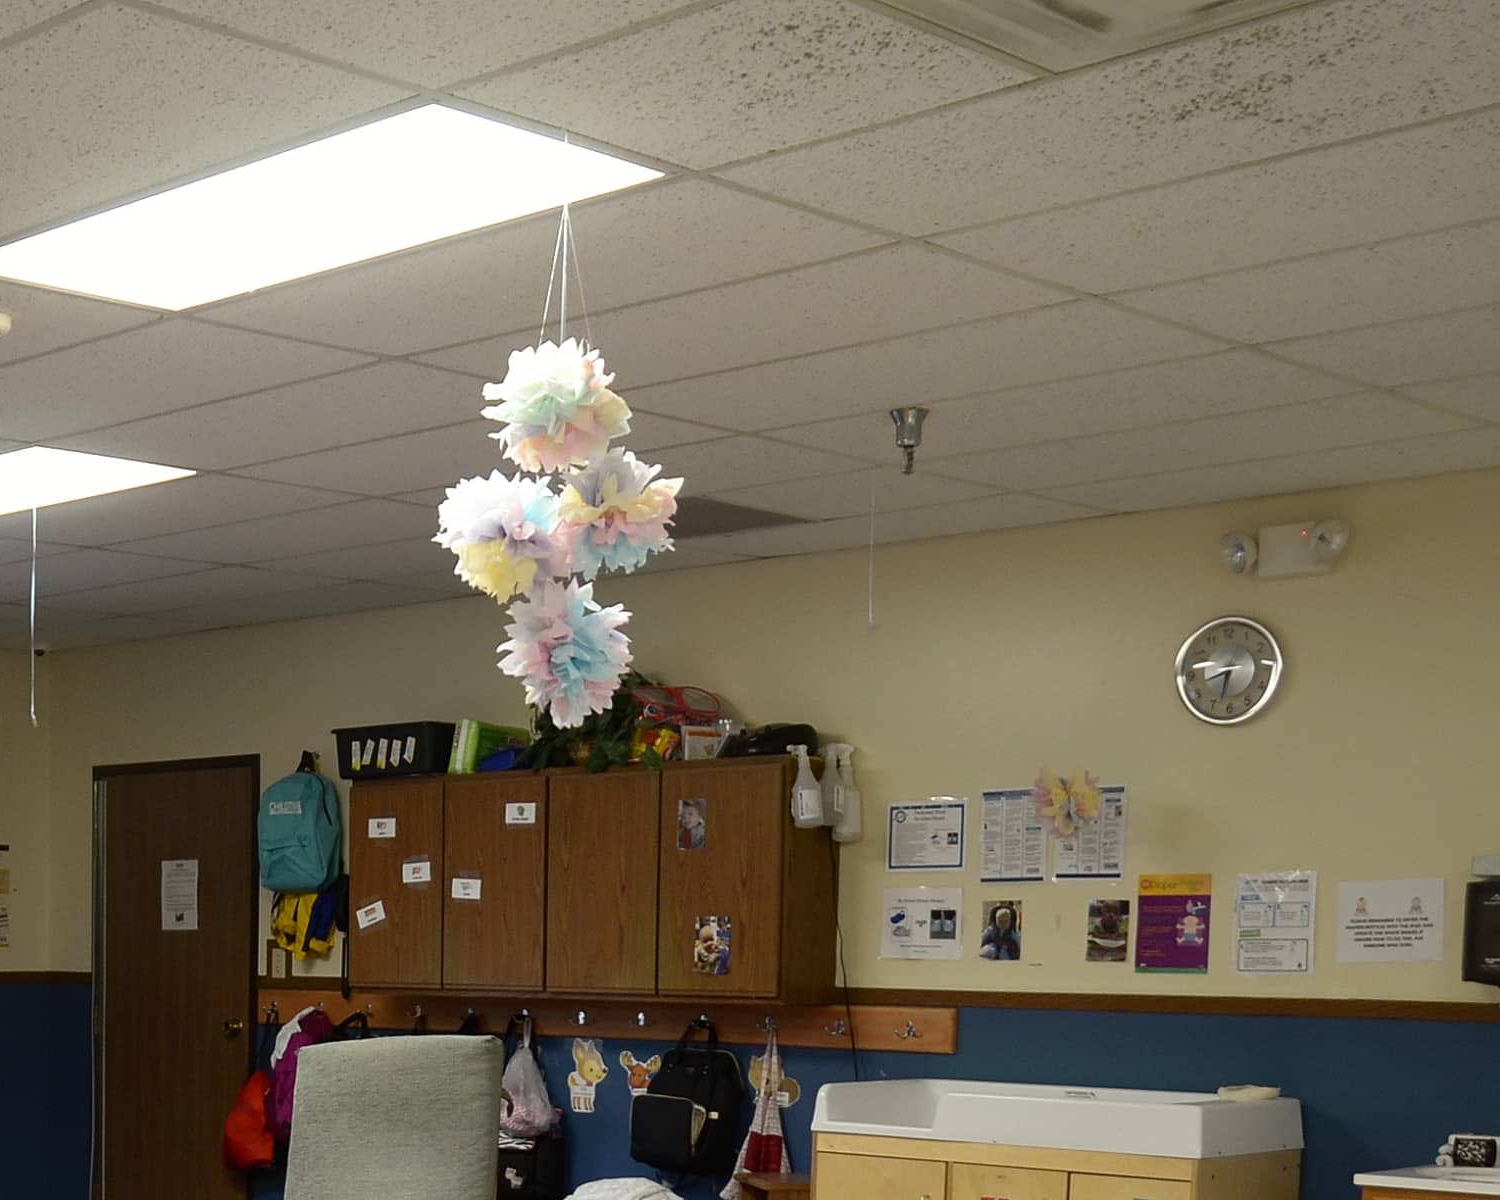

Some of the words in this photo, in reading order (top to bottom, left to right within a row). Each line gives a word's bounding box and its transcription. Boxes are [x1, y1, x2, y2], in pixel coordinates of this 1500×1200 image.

[1222, 628, 1235, 639] 12
[1244, 631, 1249, 640] 1
[1206, 636, 1216, 645] 11
[1257, 642, 1264, 652] 2
[1210, 699, 1218, 710] 7
[1244, 696, 1251, 706] 5
[1226, 702, 1234, 713] 6
